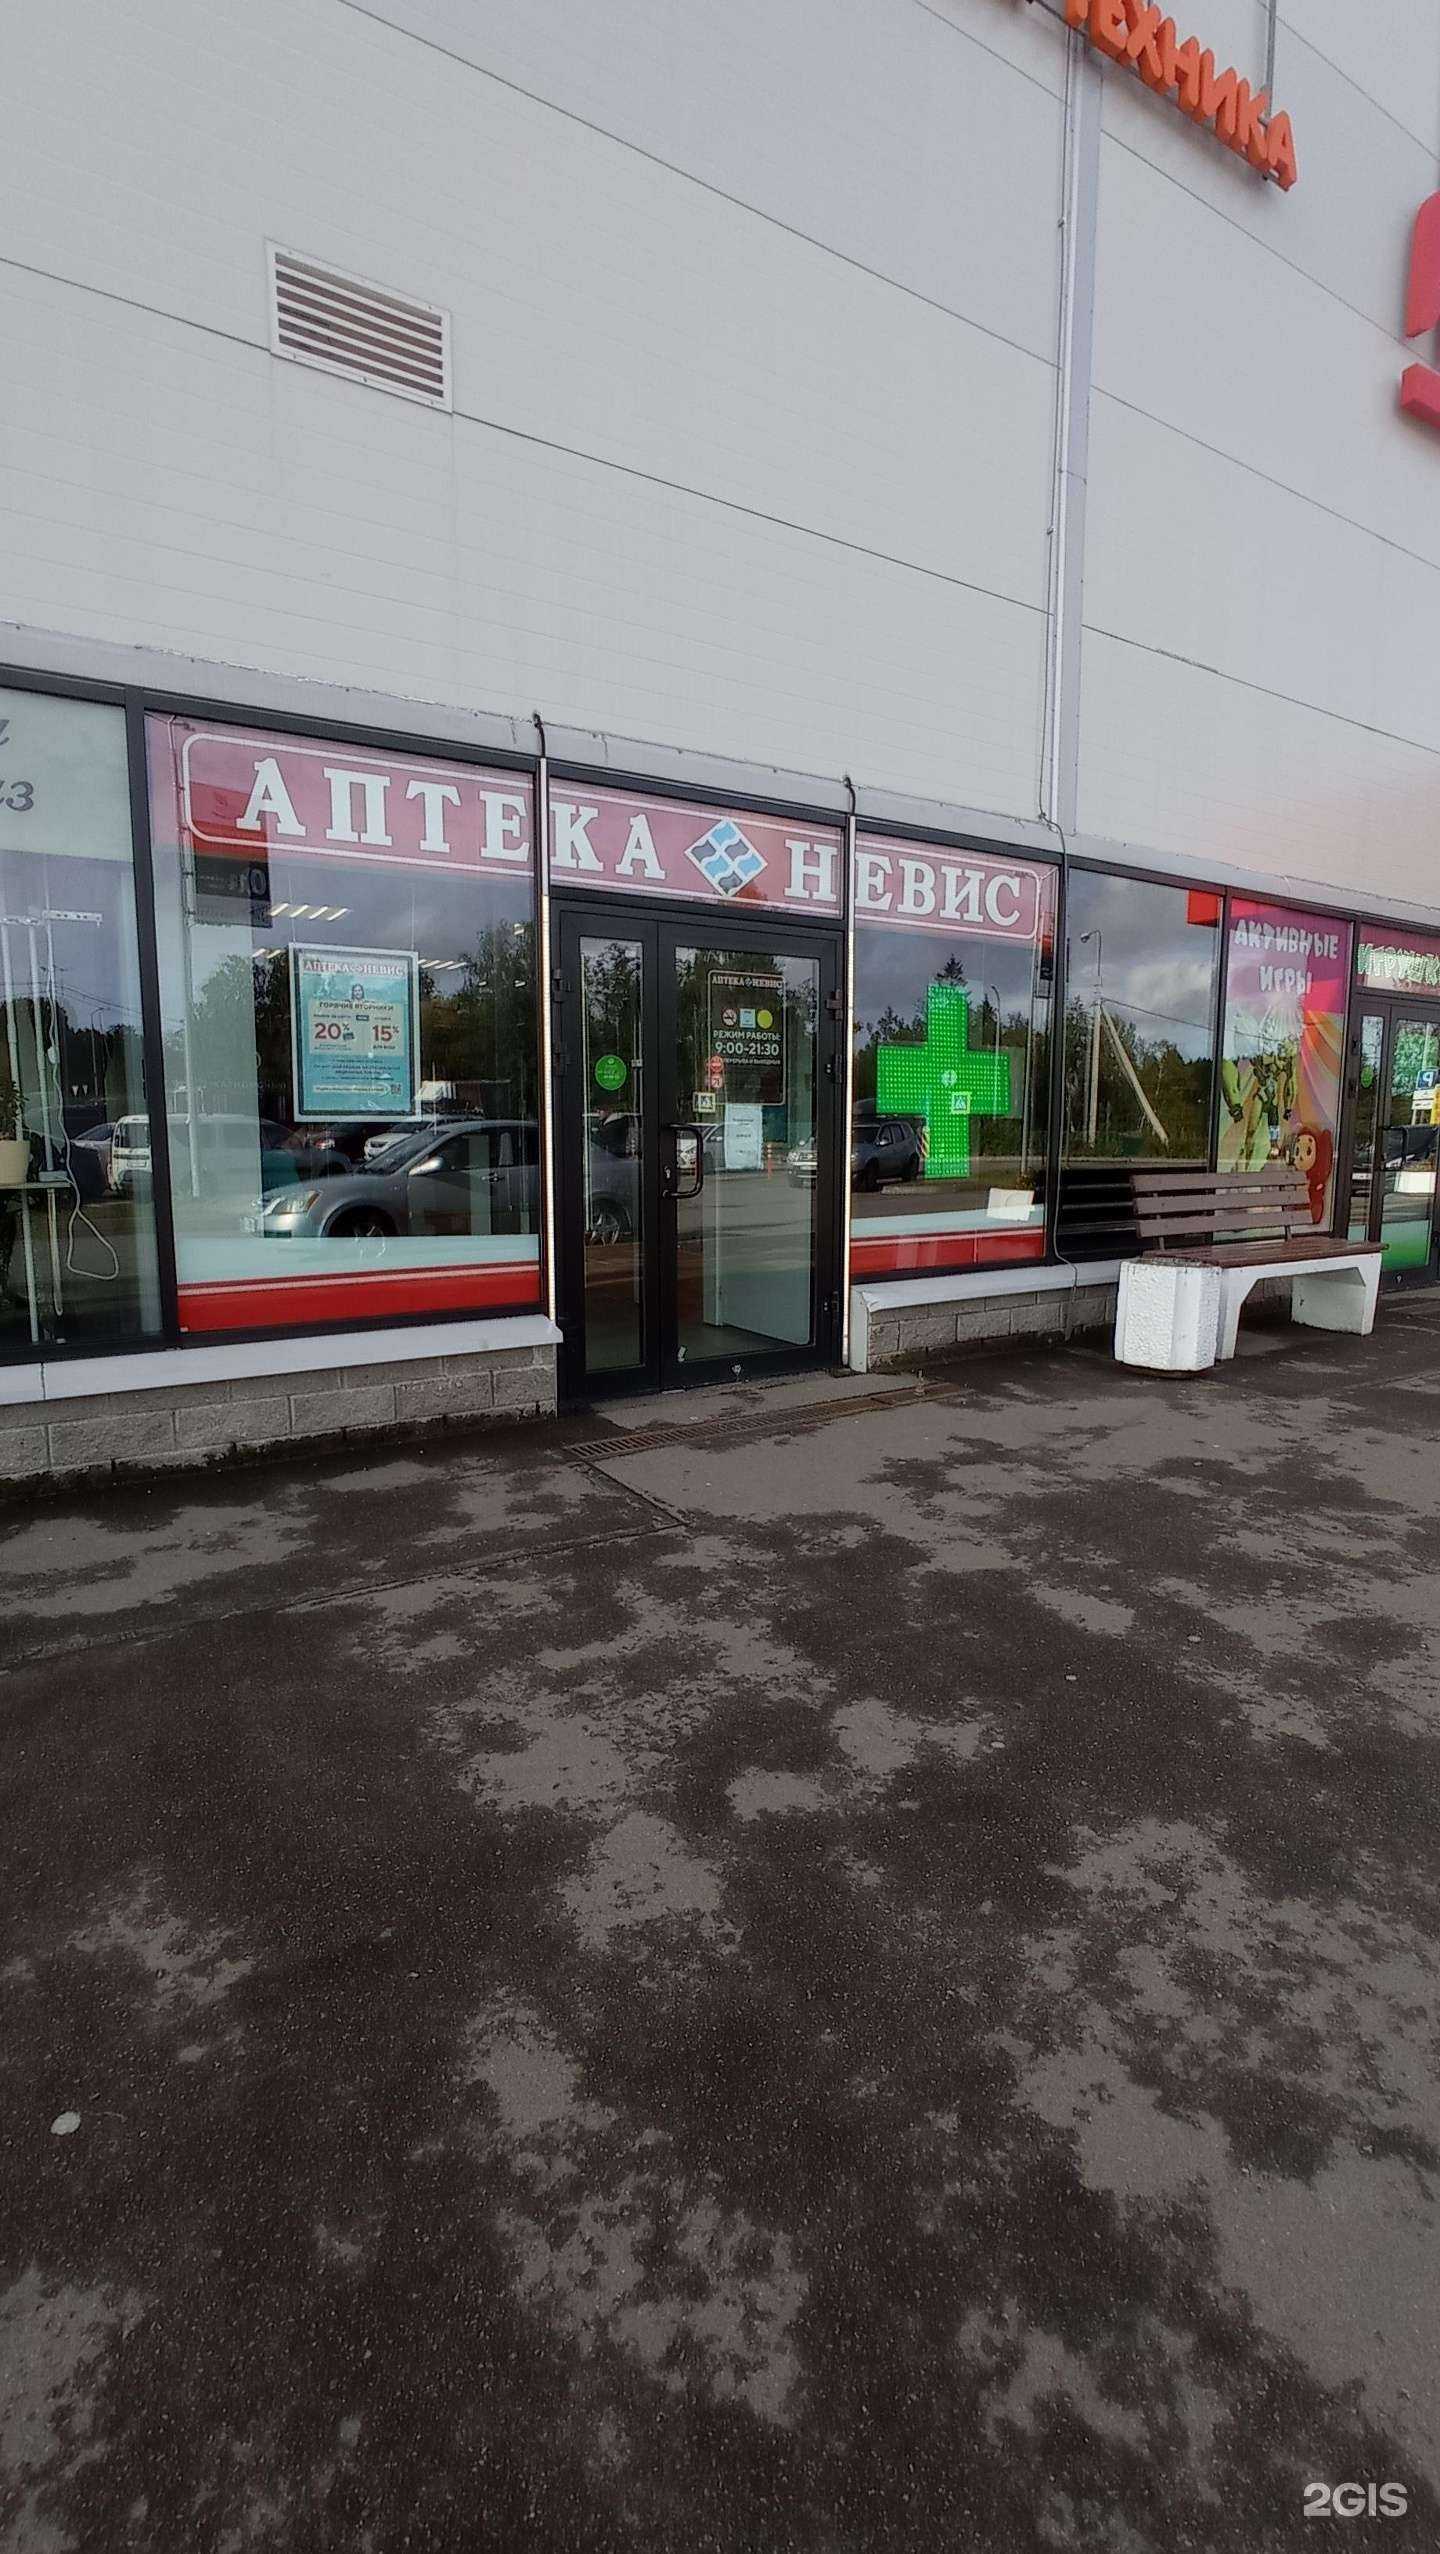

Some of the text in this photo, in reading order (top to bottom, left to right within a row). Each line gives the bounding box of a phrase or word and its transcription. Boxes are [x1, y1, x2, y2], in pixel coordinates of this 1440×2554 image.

[235, 757, 1021, 927] АПТЕКА НЕВИС
[1235, 919, 1339, 959] АКТИВНЫЕ
[304, 960, 404, 976] АПТЕКА НЕВИС
[712, 976, 783, 988] АПТЕКА НЕВИС
[1258, 965, 1313, 996] ИГРЫ
[713, 1029, 746, 1040] РЕЖИМ
[715, 1041, 780, 1056] 9:00-21:30
